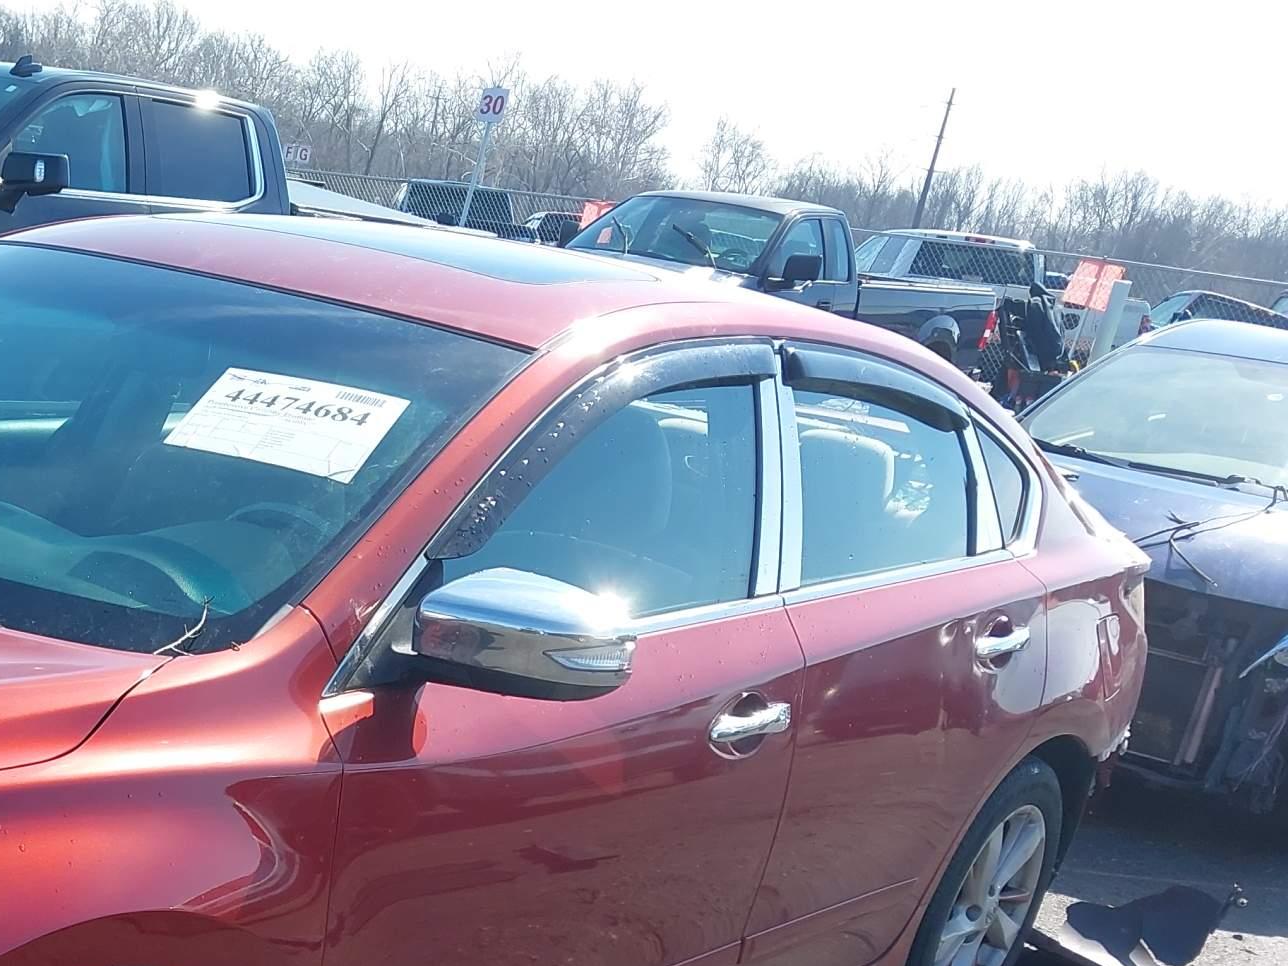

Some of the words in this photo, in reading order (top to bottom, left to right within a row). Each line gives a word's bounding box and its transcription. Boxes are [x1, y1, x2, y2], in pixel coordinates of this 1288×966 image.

[479, 94, 505, 115] 30
[285, 146, 293, 158] F
[299, 148, 309, 160] G
[225, 388, 371, 426] 44474684
